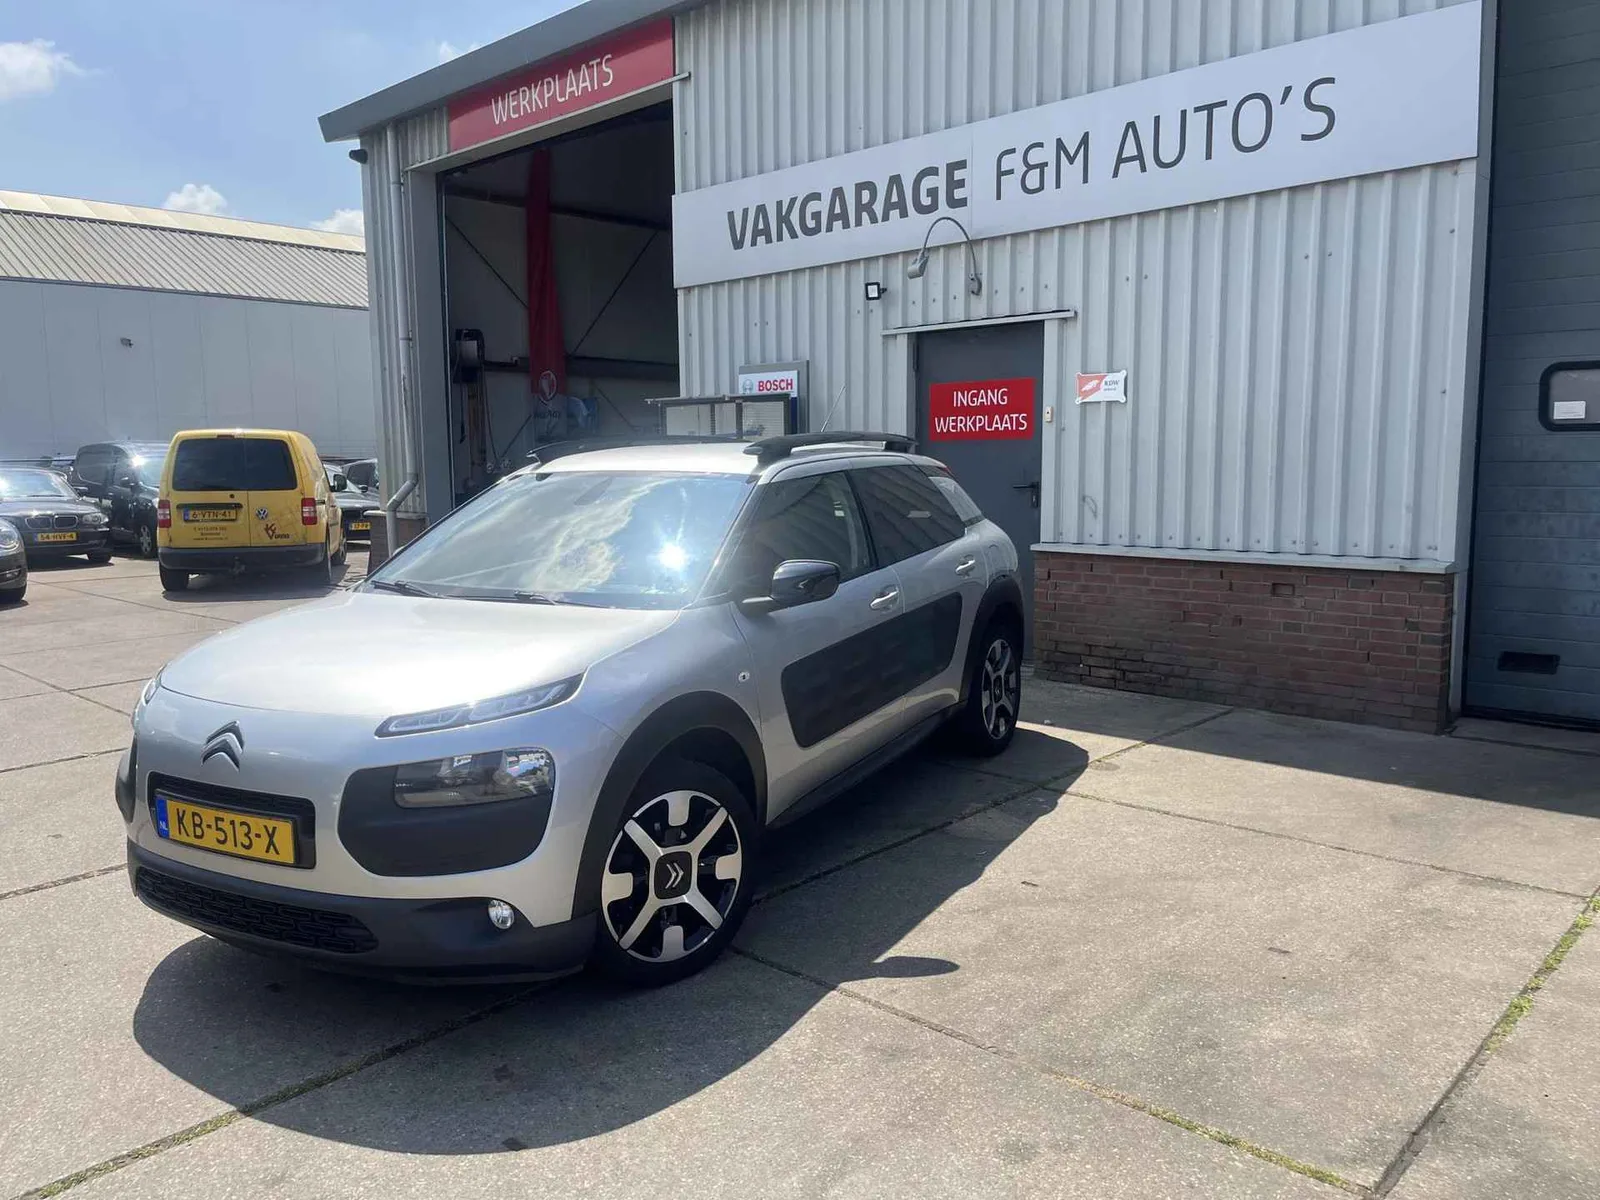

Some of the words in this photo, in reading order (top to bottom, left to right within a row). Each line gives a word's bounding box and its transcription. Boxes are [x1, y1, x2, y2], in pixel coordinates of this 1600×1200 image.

[491, 54, 614, 125] WERKPLAATS
[727, 159, 967, 250] VAKGARAGE
[996, 131, 1090, 200] F&M
[1112, 77, 1336, 179] AUTO'S
[758, 378, 793, 392] BOSCH
[953, 388, 1009, 408] INGANG
[935, 413, 1028, 433] WERKPLAATS
[192, 509, 231, 519] 6-VTN-41
[176, 807, 281, 856] KB-513-X
